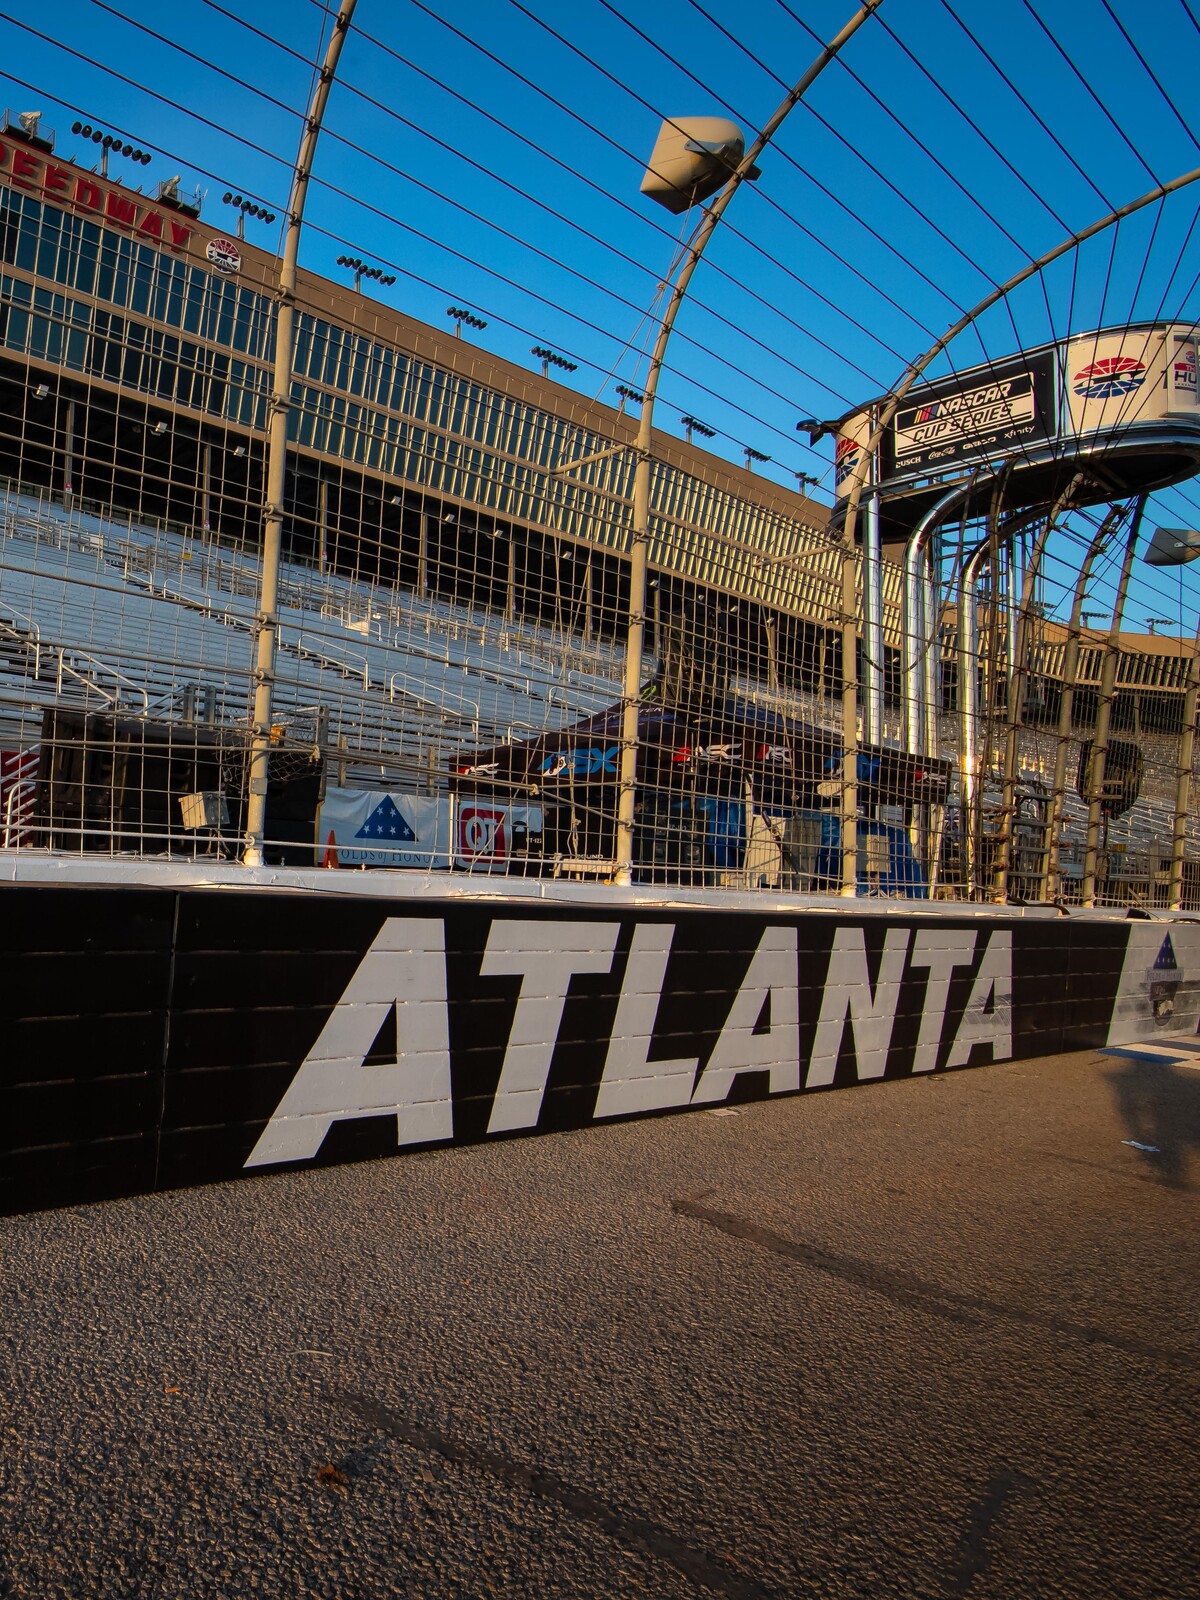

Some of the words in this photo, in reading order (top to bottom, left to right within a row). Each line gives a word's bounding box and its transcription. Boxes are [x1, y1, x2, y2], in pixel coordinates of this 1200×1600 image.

[937, 382, 1011, 417] NASCAR
[913, 422, 947, 442] CUP
[949, 403, 1013, 433] SERIES
[340, 847, 376, 861] OLDS
[464, 815, 499, 854] QT
[243, 917, 1014, 1168] ATLANTA
